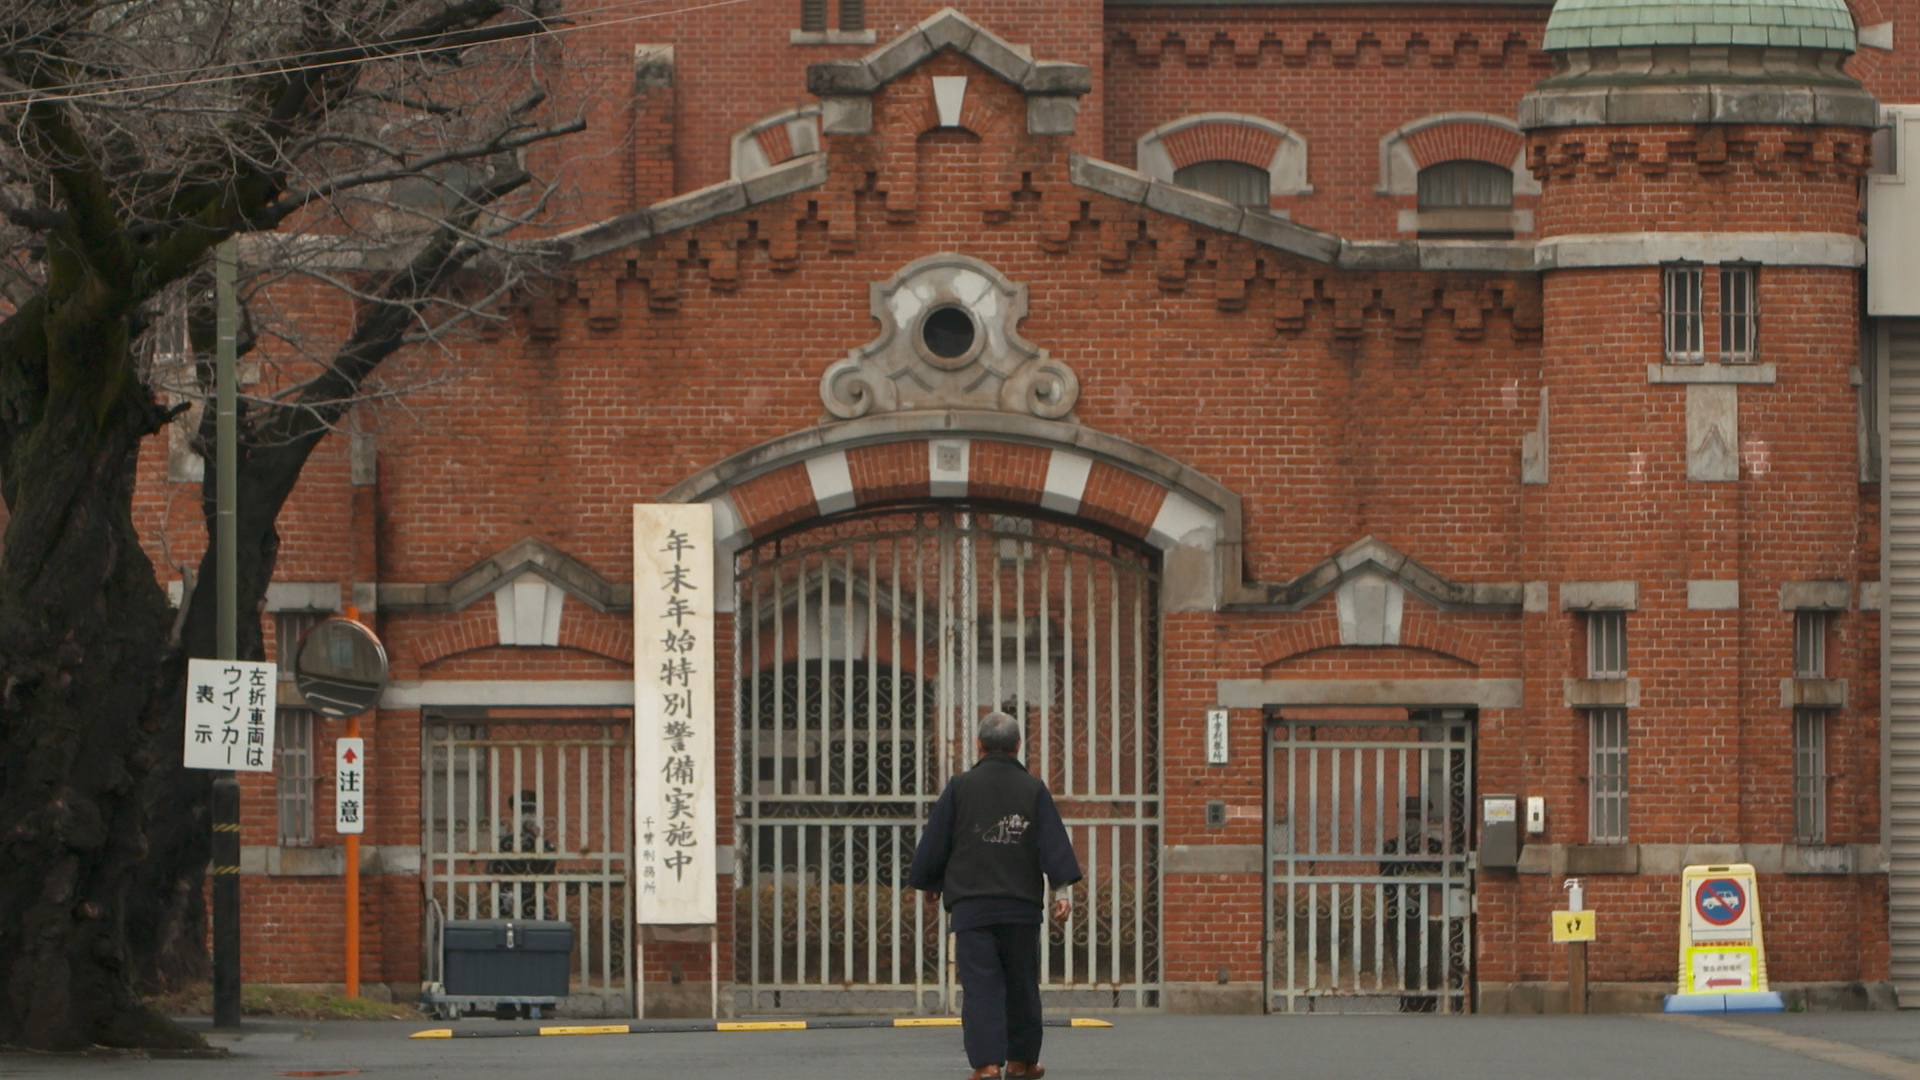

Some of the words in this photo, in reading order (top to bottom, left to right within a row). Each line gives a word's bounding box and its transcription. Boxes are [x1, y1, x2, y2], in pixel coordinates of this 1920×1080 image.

[195, 684, 214, 744] 表示
[222, 665, 242, 764] ウインカー
[246, 667, 267, 767] 左折車両は
[660, 529, 697, 883] 年末年始特別警備実施中
[339, 769, 360, 824] 注意
[643, 816, 656, 894] 千葉刑務所
